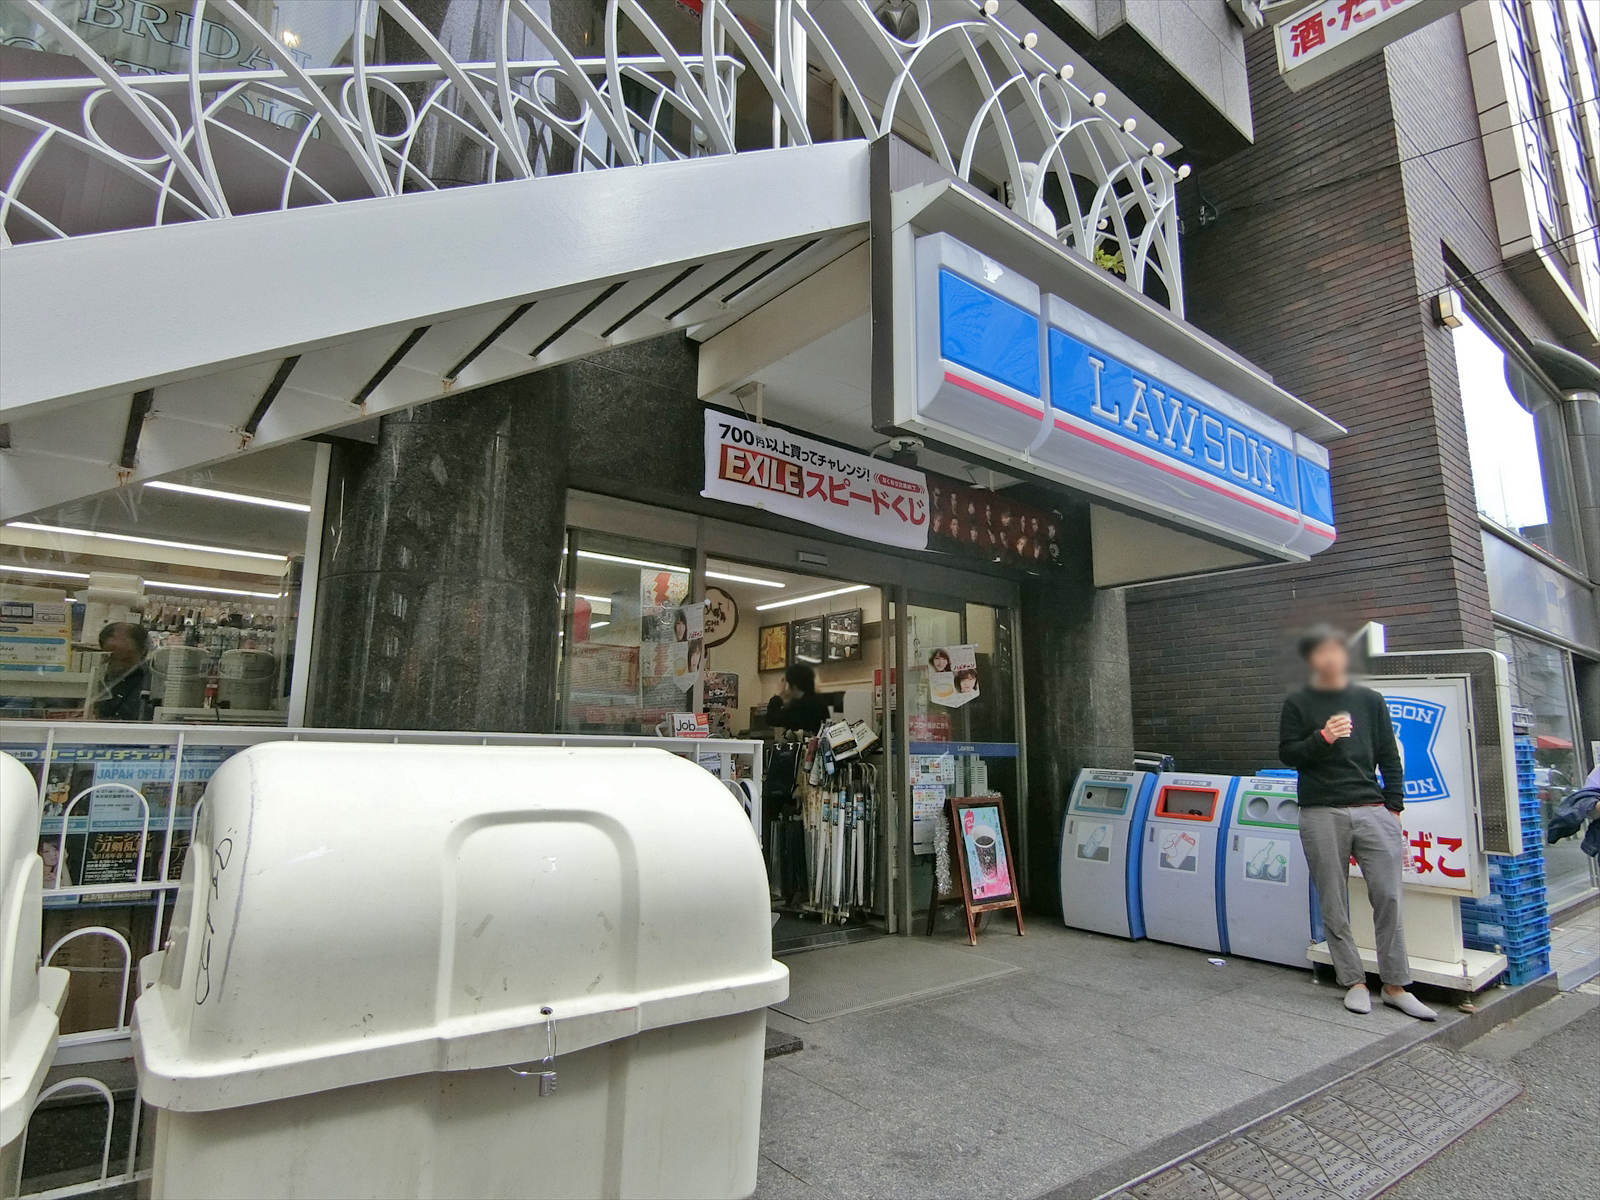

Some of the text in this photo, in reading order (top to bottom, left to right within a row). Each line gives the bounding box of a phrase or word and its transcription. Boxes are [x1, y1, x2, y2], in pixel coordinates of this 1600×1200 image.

[1088, 355, 1276, 494] LAWSON
[676, 719, 695, 732] Job
[97, 768, 134, 779] JAPAN
[137, 768, 167, 779] OPEN
[1403, 829, 1467, 878] ばこ
